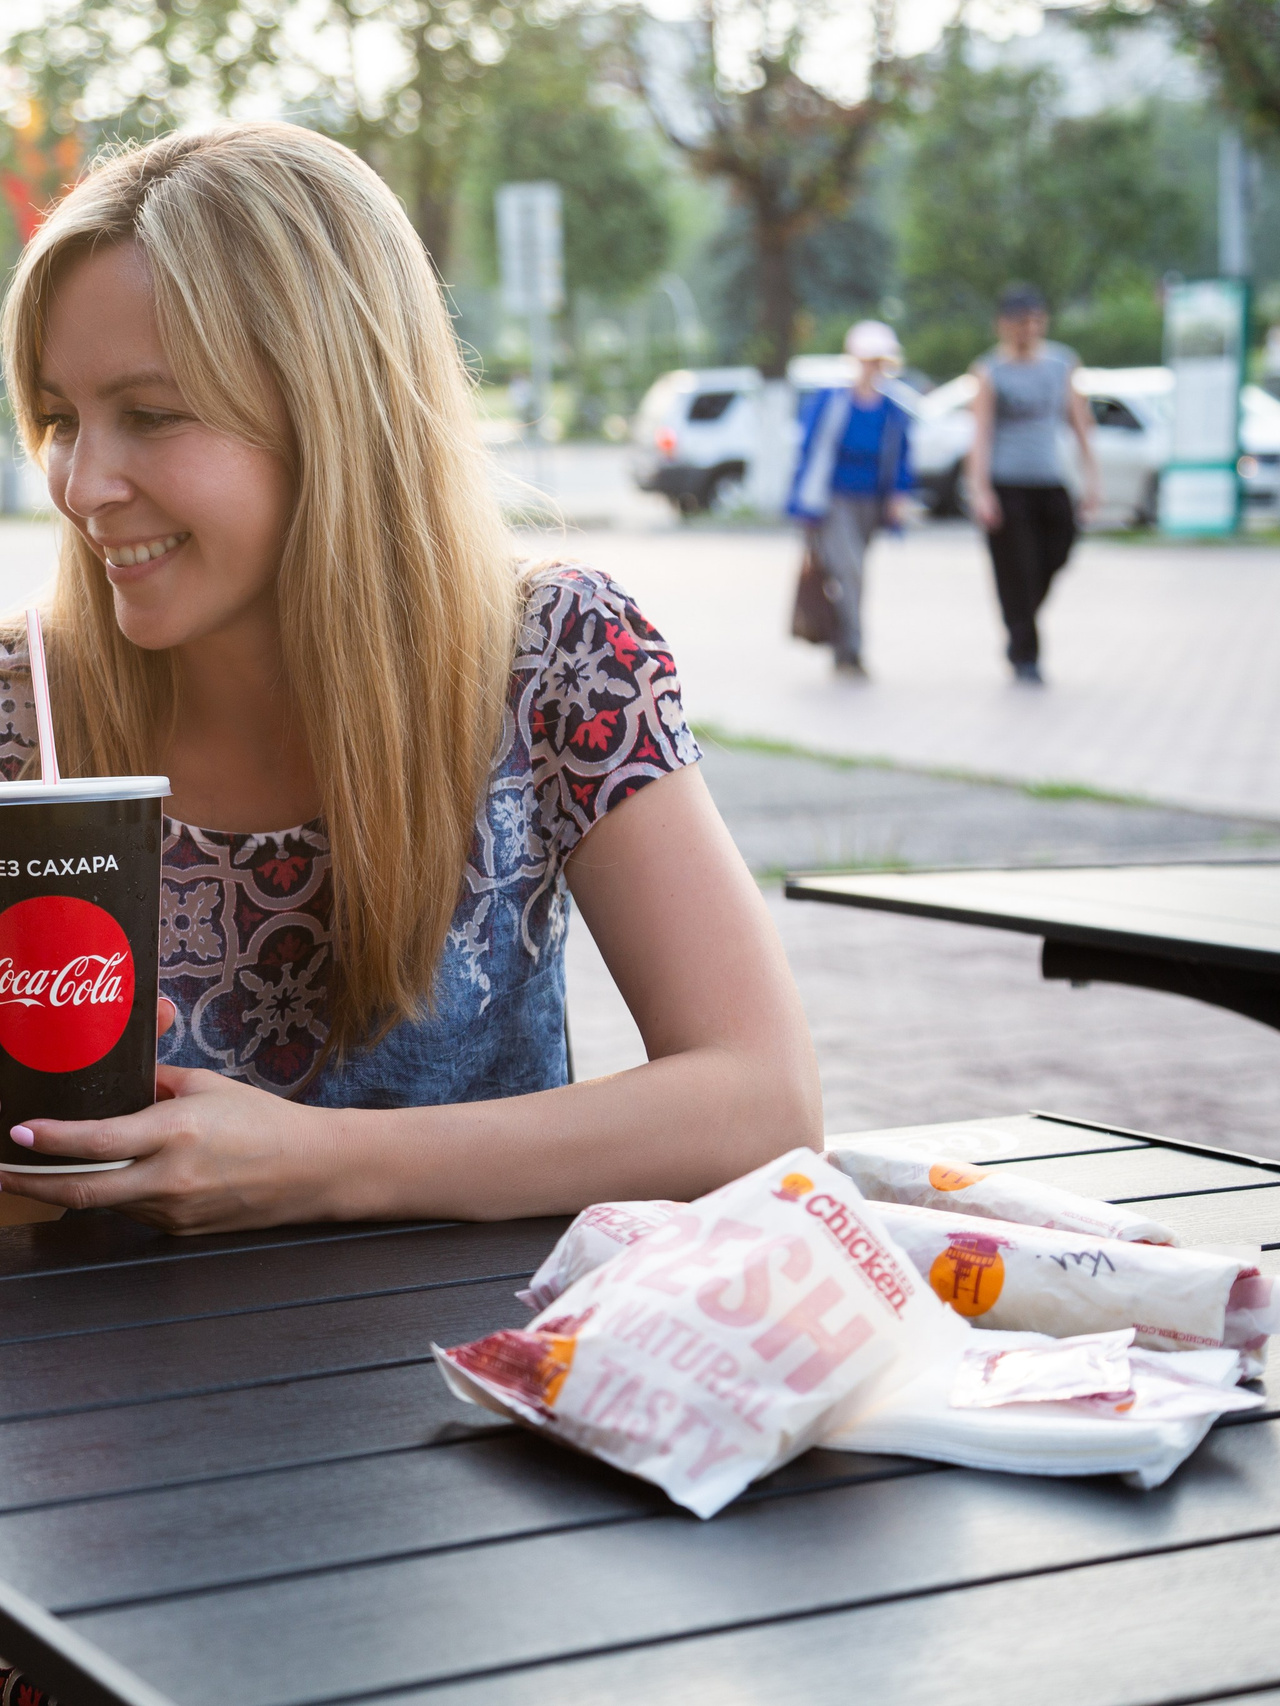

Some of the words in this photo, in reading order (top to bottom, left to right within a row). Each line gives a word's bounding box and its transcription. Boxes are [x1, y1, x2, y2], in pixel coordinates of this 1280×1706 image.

[26, 854, 119, 877] САХАРА
[590, 1213, 875, 1395] RESH
[804, 1194, 908, 1314] Chicken
[581, 1356, 742, 1481] TASTY
[601, 1300, 775, 1435] NATURAL
